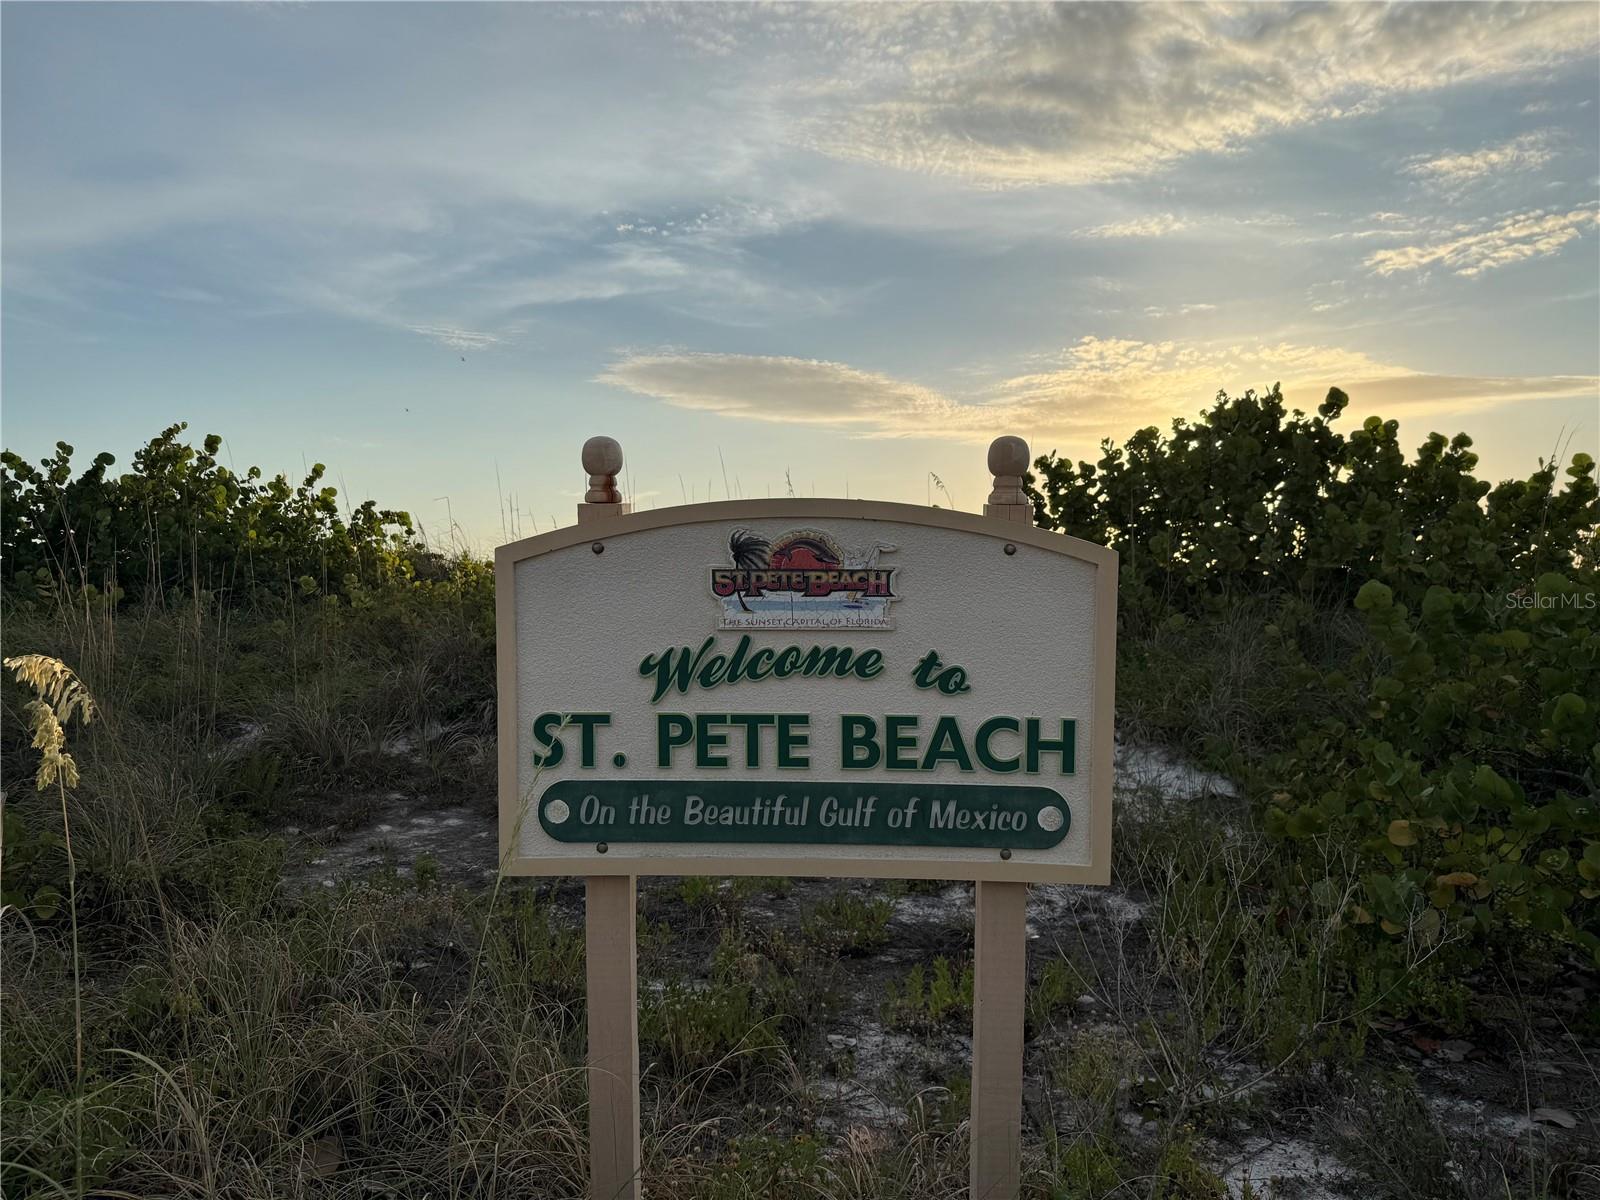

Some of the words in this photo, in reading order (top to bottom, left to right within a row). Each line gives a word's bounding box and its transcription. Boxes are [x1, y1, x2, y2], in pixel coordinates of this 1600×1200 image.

[746, 570, 805, 596] PETE
[804, 570, 894, 596] BEACH
[723, 617, 742, 626] THE
[745, 617, 783, 626] SUNSET
[785, 617, 828, 626] CAPITAL
[830, 617, 843, 626] OF
[847, 617, 887, 626] FLORIDA
[639, 634, 884, 704] Welcome
[912, 649, 971, 694] to
[533, 712, 627, 768] ST.
[657, 712, 810, 768] PETE
[841, 714, 1076, 774] BEACH
[579, 795, 615, 825] On
[628, 795, 671, 824] the
[684, 794, 809, 826] Beautiful
[819, 797, 879, 828] Gulf
[887, 797, 921, 828] of
[929, 800, 1028, 831] Mexico
